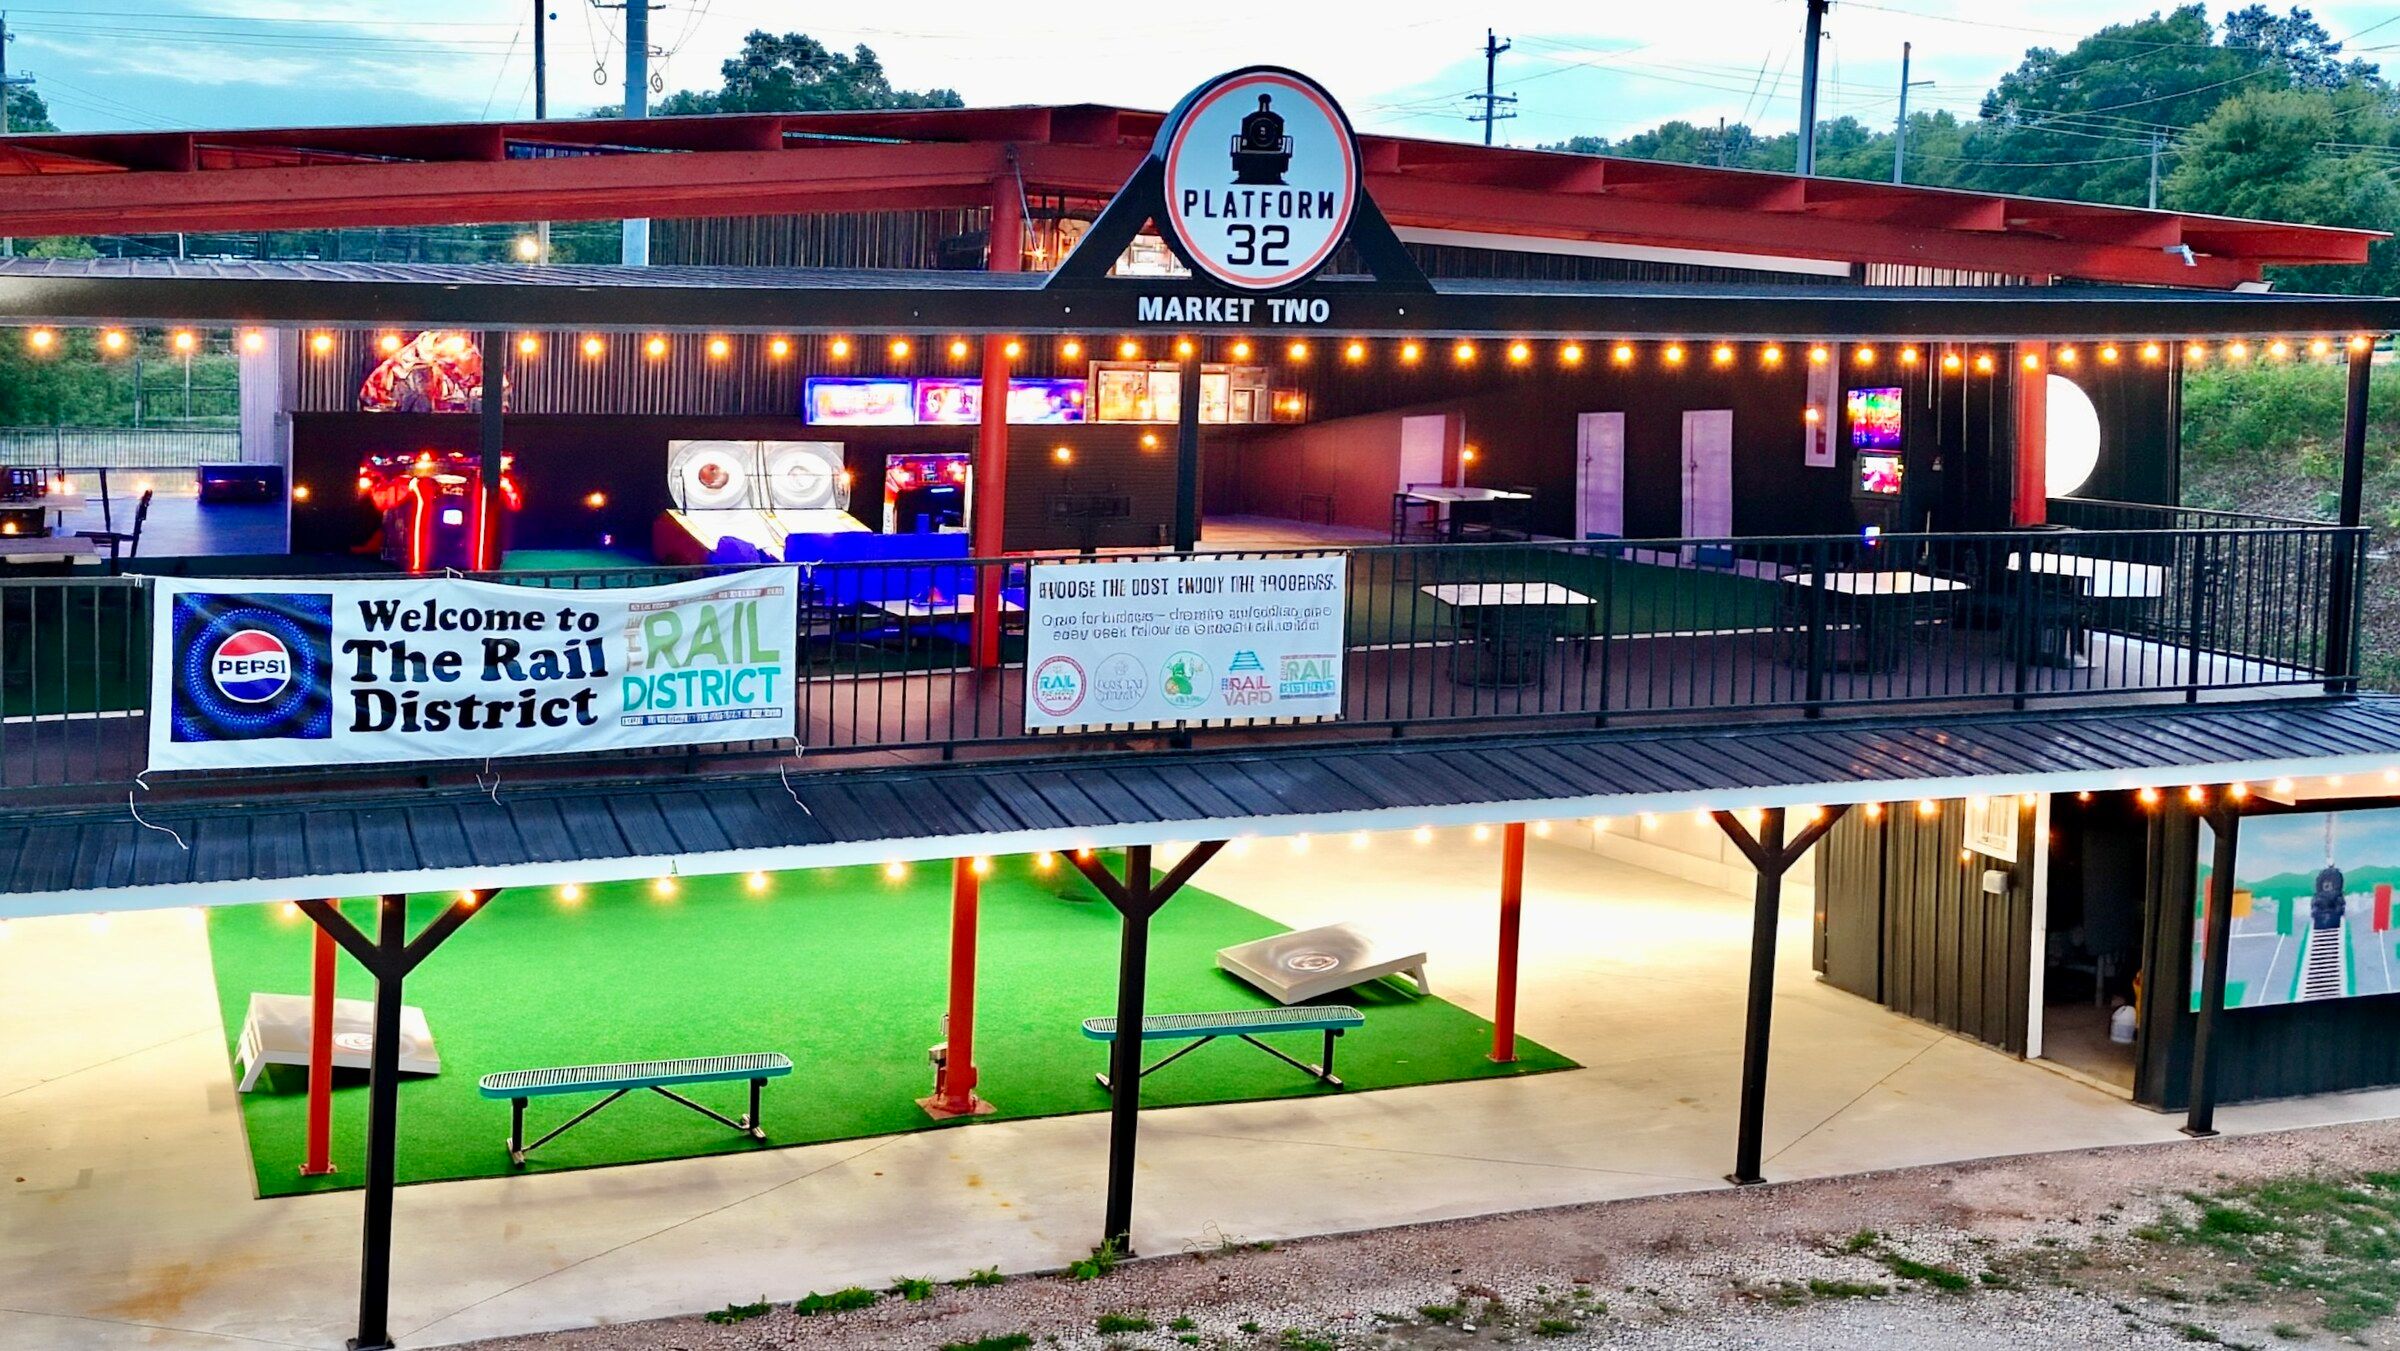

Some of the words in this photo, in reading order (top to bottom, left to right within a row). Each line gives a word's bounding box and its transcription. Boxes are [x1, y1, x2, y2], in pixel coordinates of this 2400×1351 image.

[1184, 190, 1335, 219] PLATFORM
[1227, 224, 1290, 266] 32
[1138, 297, 1254, 323] MARKET
[1267, 298, 1330, 323] TWO
[358, 599, 546, 632] Welcome
[556, 607, 600, 632] to
[644, 600, 780, 669] RAIL
[218, 660, 286, 675] PEPSI
[342, 639, 463, 682] The
[481, 637, 609, 681] Rail
[349, 688, 598, 732] District
[623, 667, 781, 711] DISTRICT
